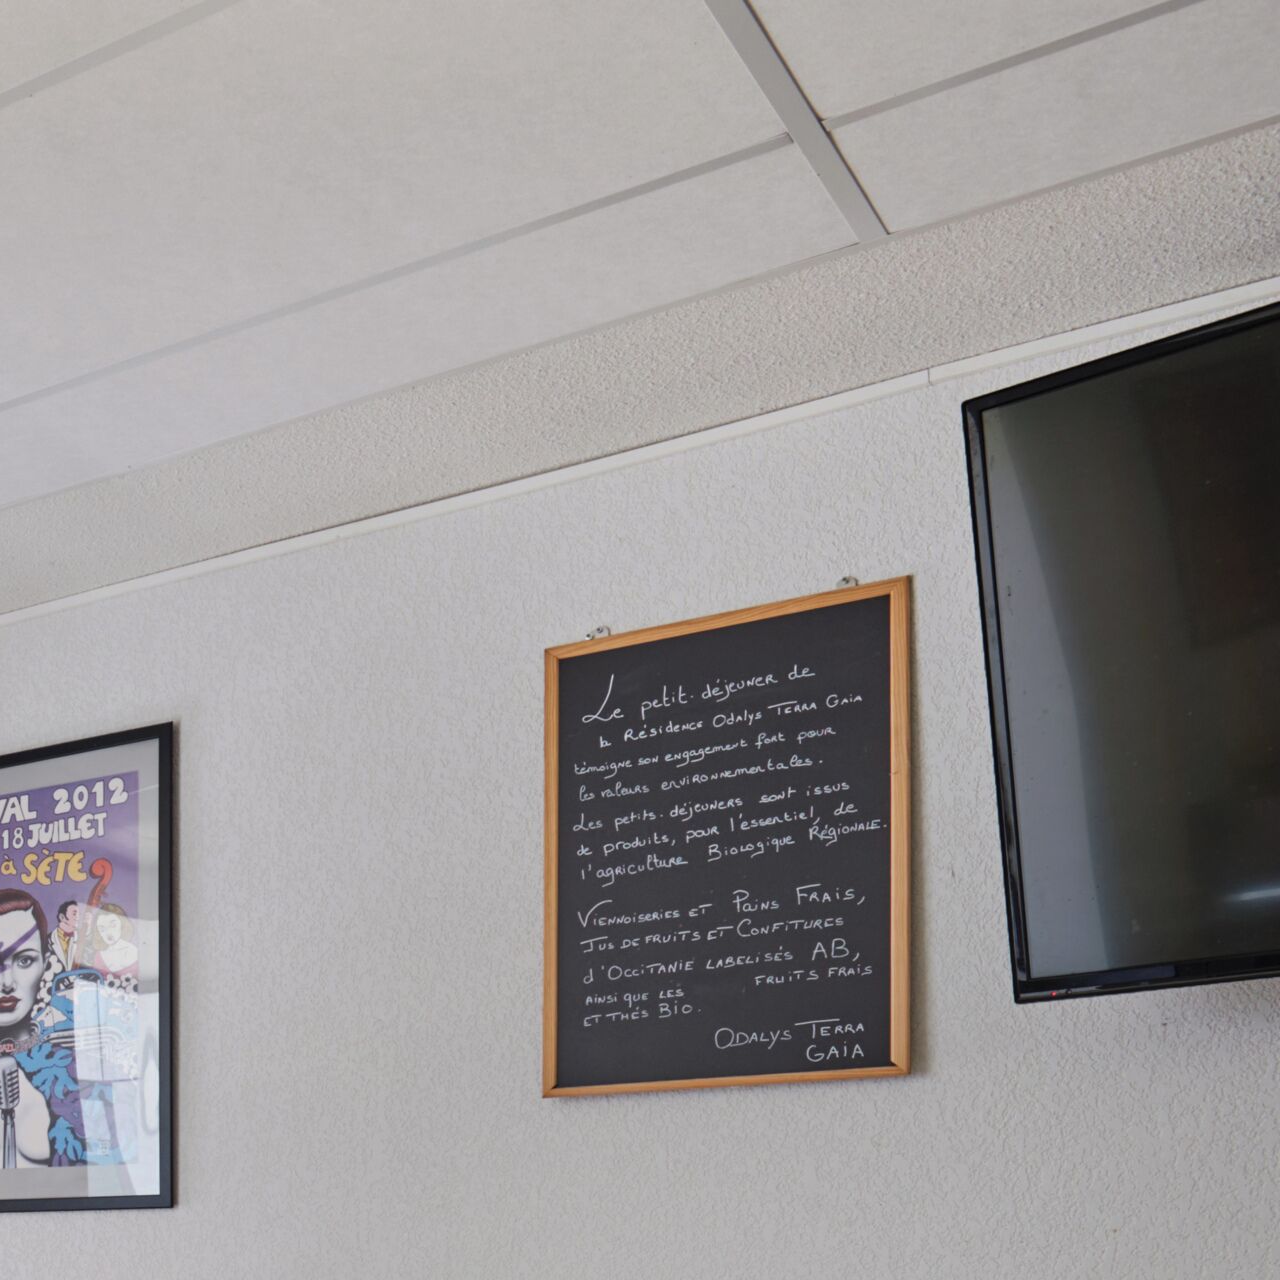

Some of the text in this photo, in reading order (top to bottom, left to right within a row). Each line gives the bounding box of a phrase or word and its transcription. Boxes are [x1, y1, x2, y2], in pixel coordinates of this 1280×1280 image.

[582, 674, 624, 723] Le
[788, 664, 816, 680] de
[713, 710, 762, 727] Odalys
[574, 727, 836, 779] témoigne son engagement fort pour
[53, 777, 128, 814] 2012
[573, 813, 603, 832] Les
[759, 786, 797, 803] sont
[806, 782, 850, 796] issus
[579, 785, 595, 802] les
[601, 781, 650, 798] valeurs
[2, 827, 24, 850] 18
[27, 813, 107, 848] JUILLET
[577, 845, 592, 856] de
[603, 832, 676, 856] produits,
[686, 826, 720, 844] pour
[834, 802, 858, 816] de
[0, 856, 17, 875] à
[20, 849, 88, 885] SÈTE
[581, 854, 689, 887] l'agriculture
[708, 835, 795, 862] Biologique
[689, 903, 713, 917] ET
[620, 938, 641, 949] DE
[645, 931, 701, 943] FRUITS
[707, 926, 734, 940] ET
[737, 917, 844, 937] CONFITURES
[811, 938, 860, 962] AB,
[585, 992, 618, 1006] AINSI
[659, 988, 685, 999] LES
[754, 970, 819, 986] FRUITS
[828, 964, 873, 978] FRAIS
[583, 1014, 602, 1027] ET
[605, 1006, 650, 1022] THÉS
[714, 1018, 865, 1050] ODALYS TERRA
[806, 1041, 865, 1062] GAIA
